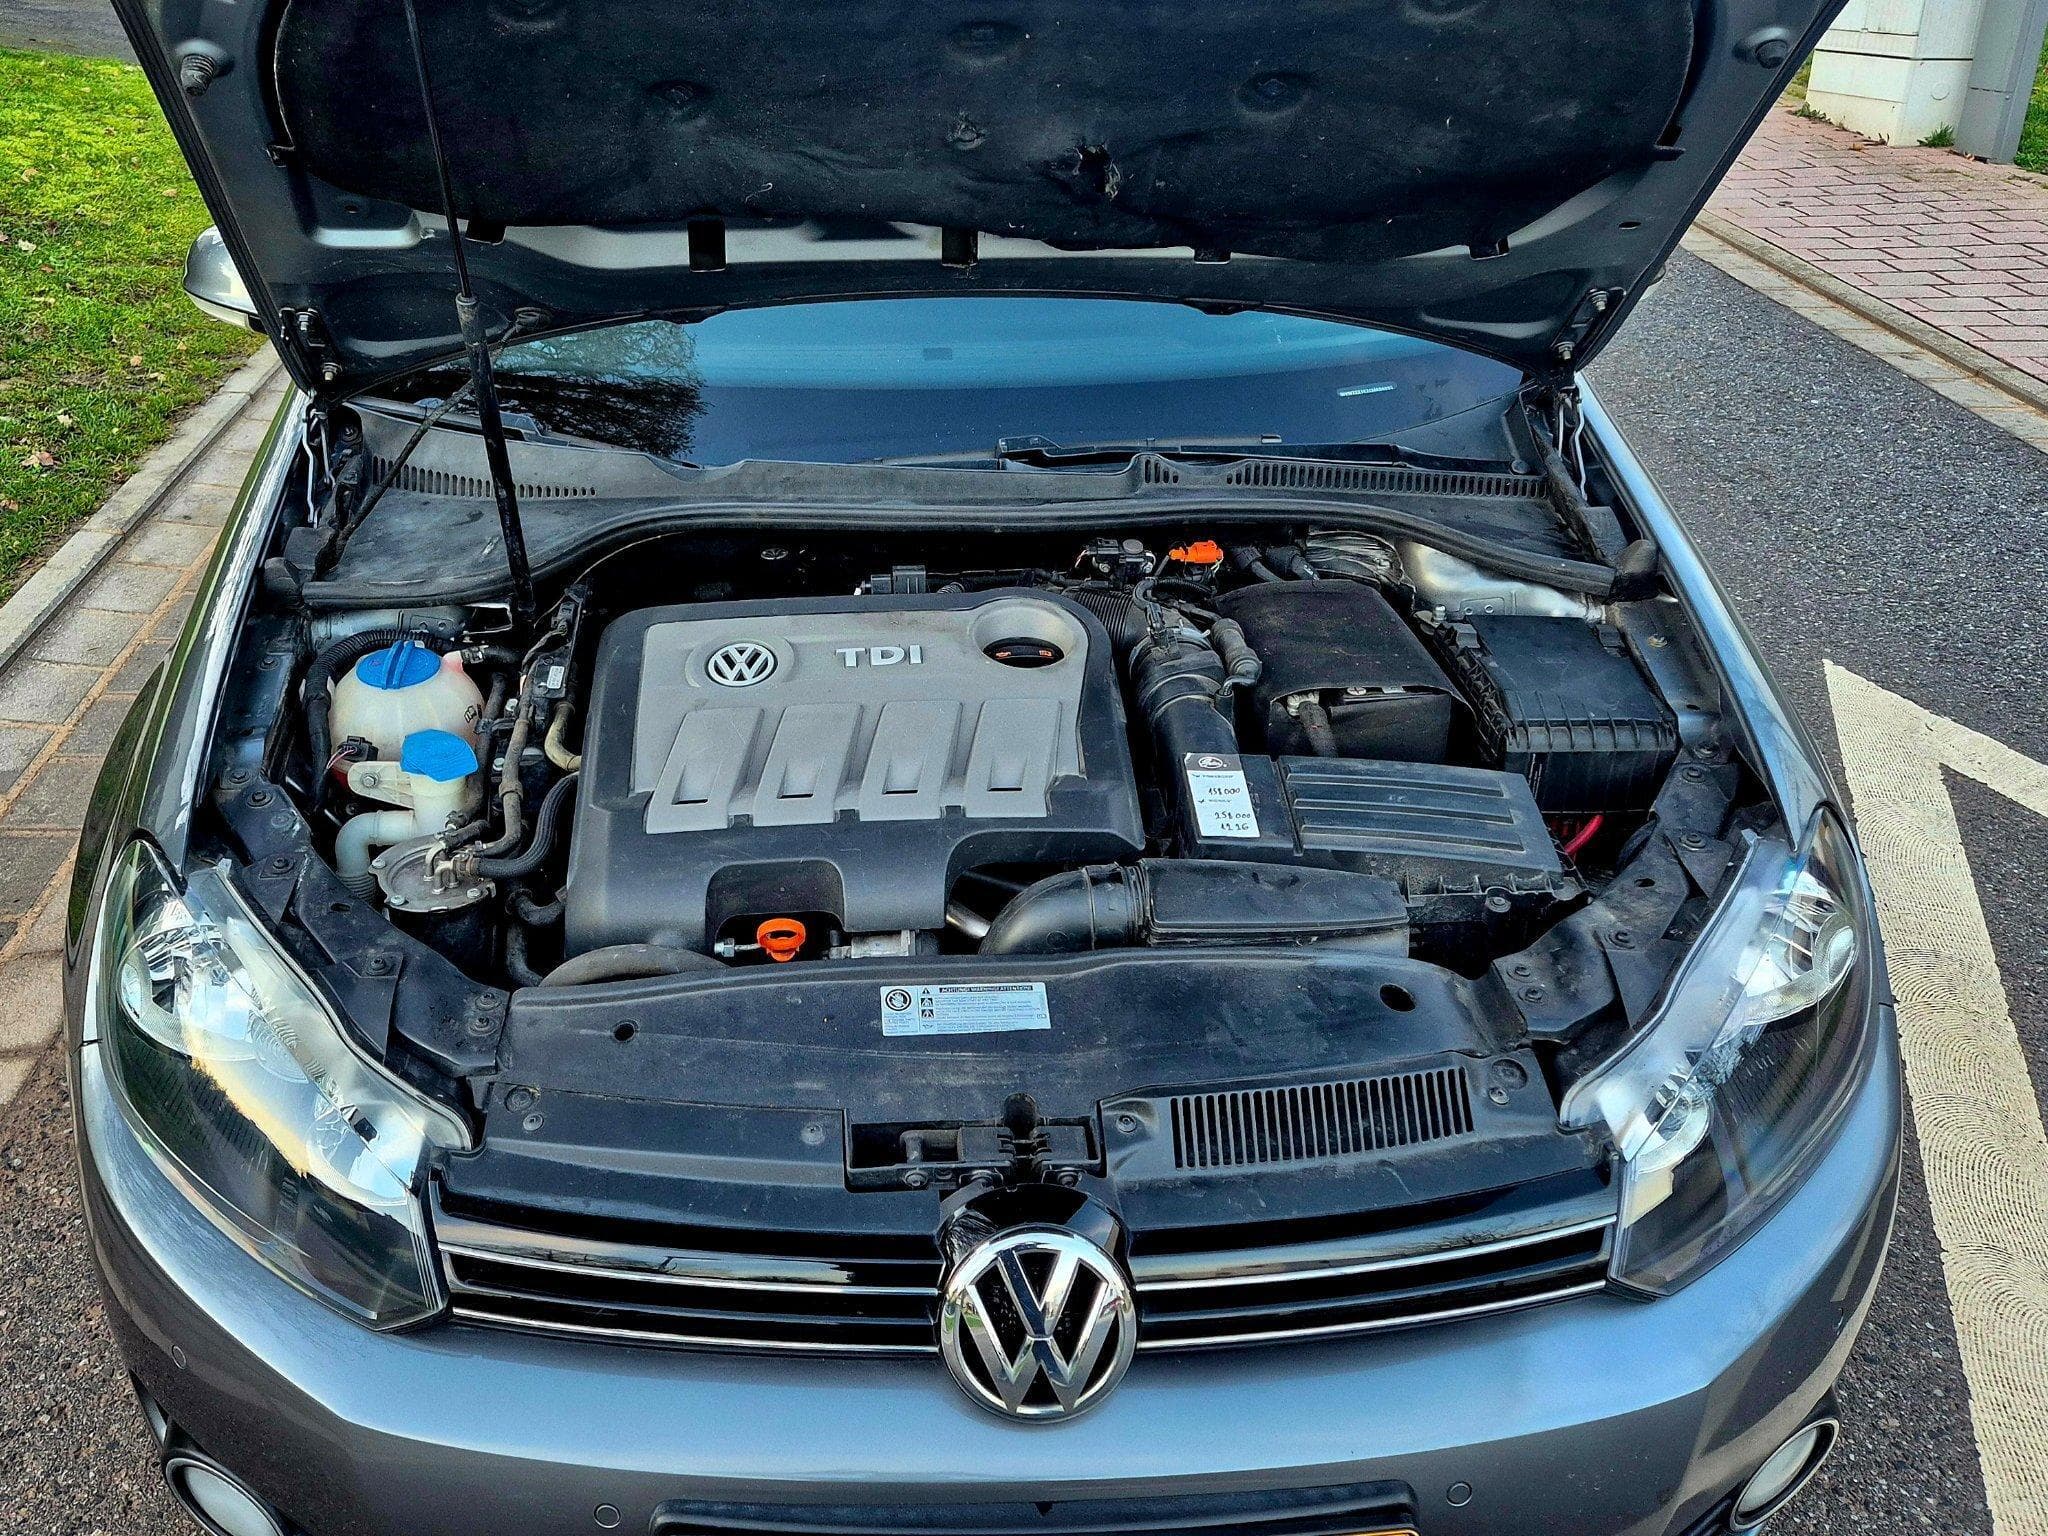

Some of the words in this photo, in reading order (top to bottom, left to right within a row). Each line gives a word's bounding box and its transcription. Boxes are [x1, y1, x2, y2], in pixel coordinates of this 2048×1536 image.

[708, 643, 774, 686] VW
[836, 644, 922, 668] TDI
[947, 1232, 1129, 1419] VW
